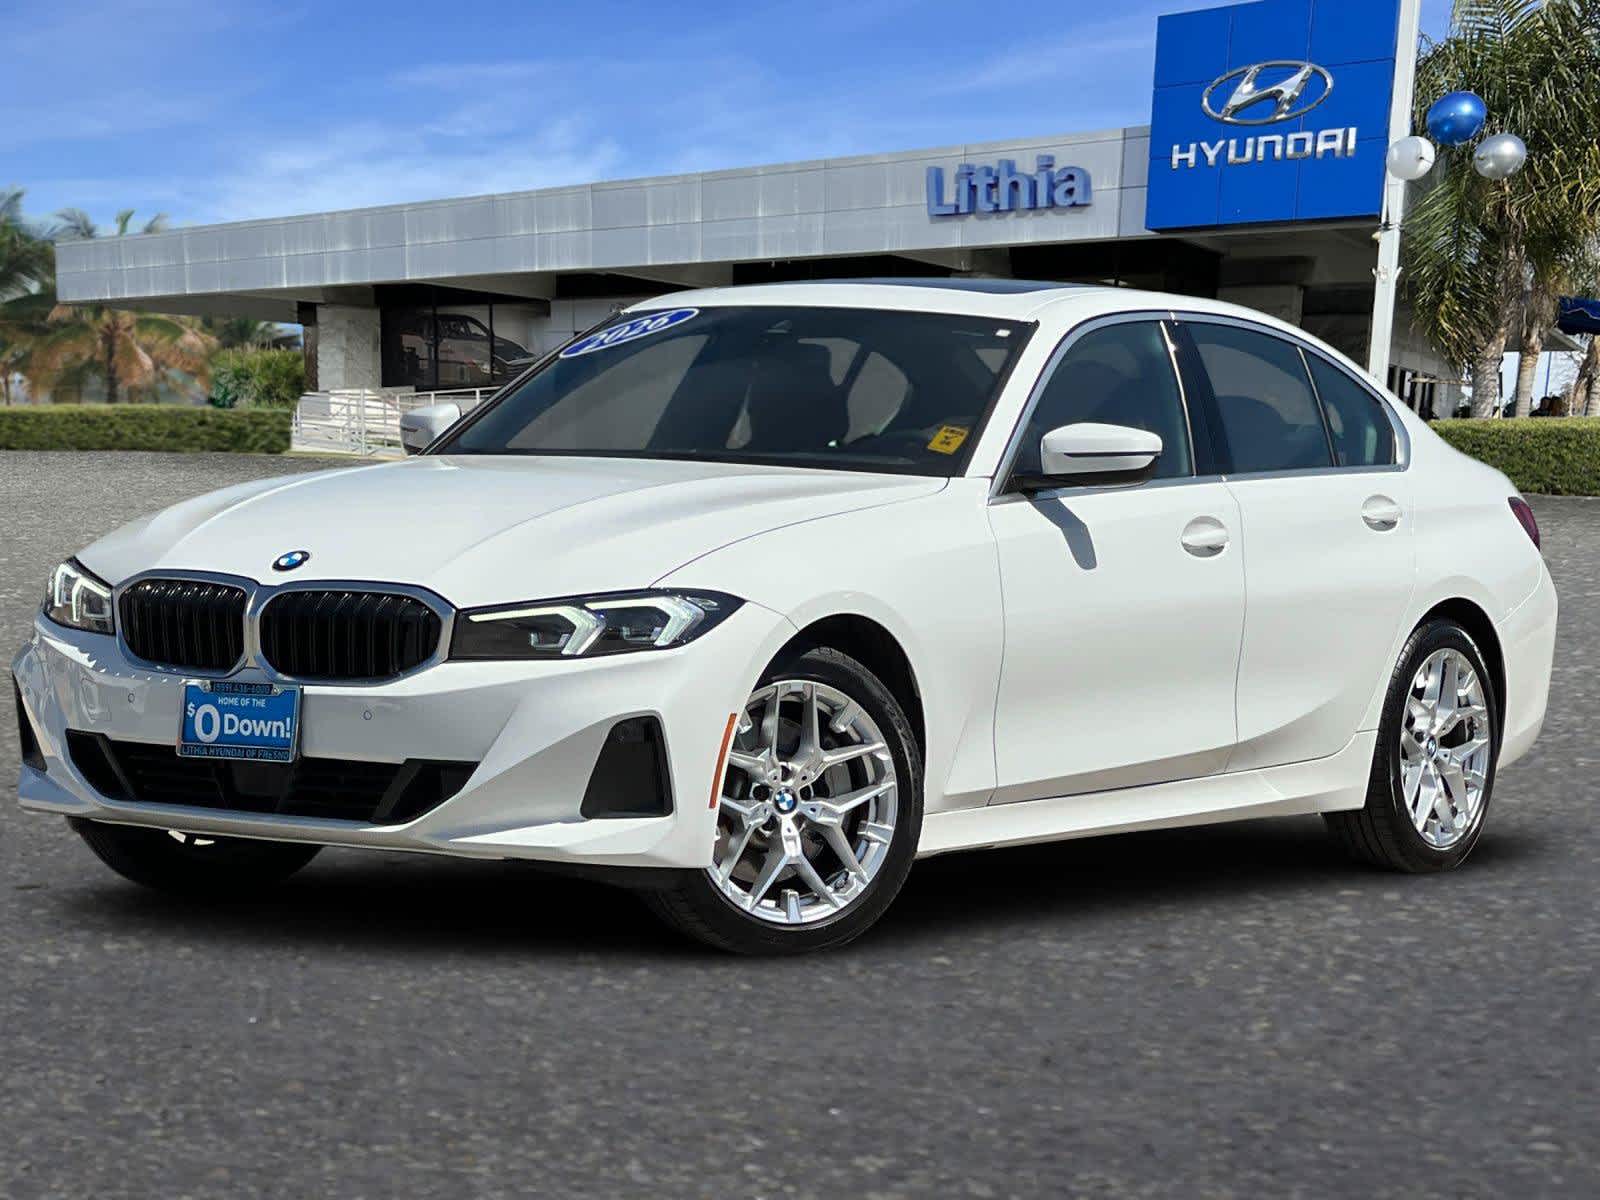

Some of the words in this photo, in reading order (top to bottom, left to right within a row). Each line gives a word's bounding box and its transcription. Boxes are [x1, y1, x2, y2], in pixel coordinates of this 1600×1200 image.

[1171, 127, 1357, 169] HYUNDAI
[925, 155, 1092, 217] Lithia
[218, 697, 239, 706] HOME
[241, 698, 250, 707] OF
[252, 698, 266, 708] THE
[223, 713, 291, 738] Down!
